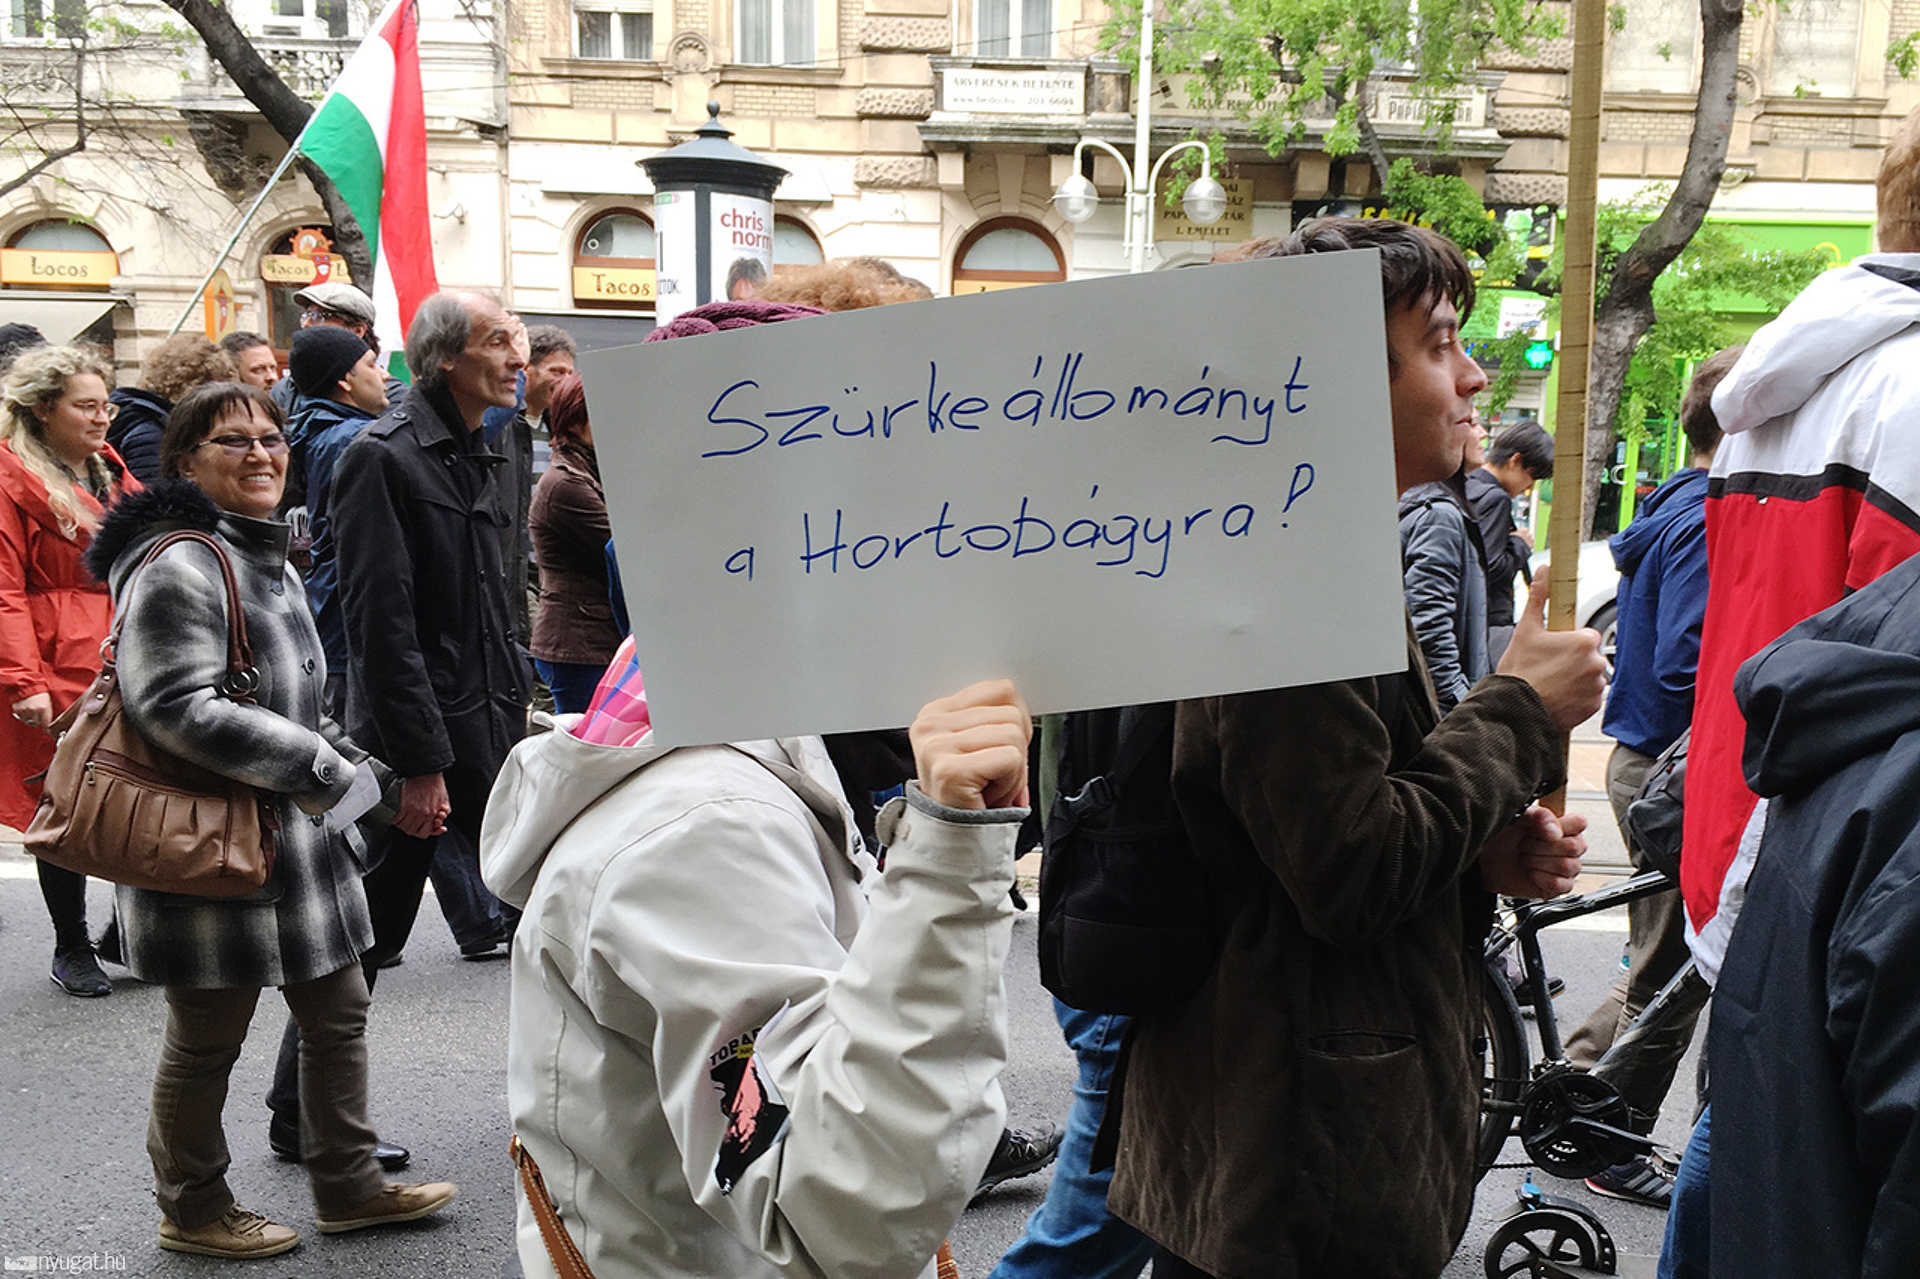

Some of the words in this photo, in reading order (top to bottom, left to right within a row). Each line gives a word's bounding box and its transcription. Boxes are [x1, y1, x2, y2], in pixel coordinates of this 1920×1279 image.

[720, 208, 764, 232] chris
[591, 272, 651, 297] Tacos
[702, 352, 1309, 458] Szürkeállományt
[724, 546, 756, 583] a
